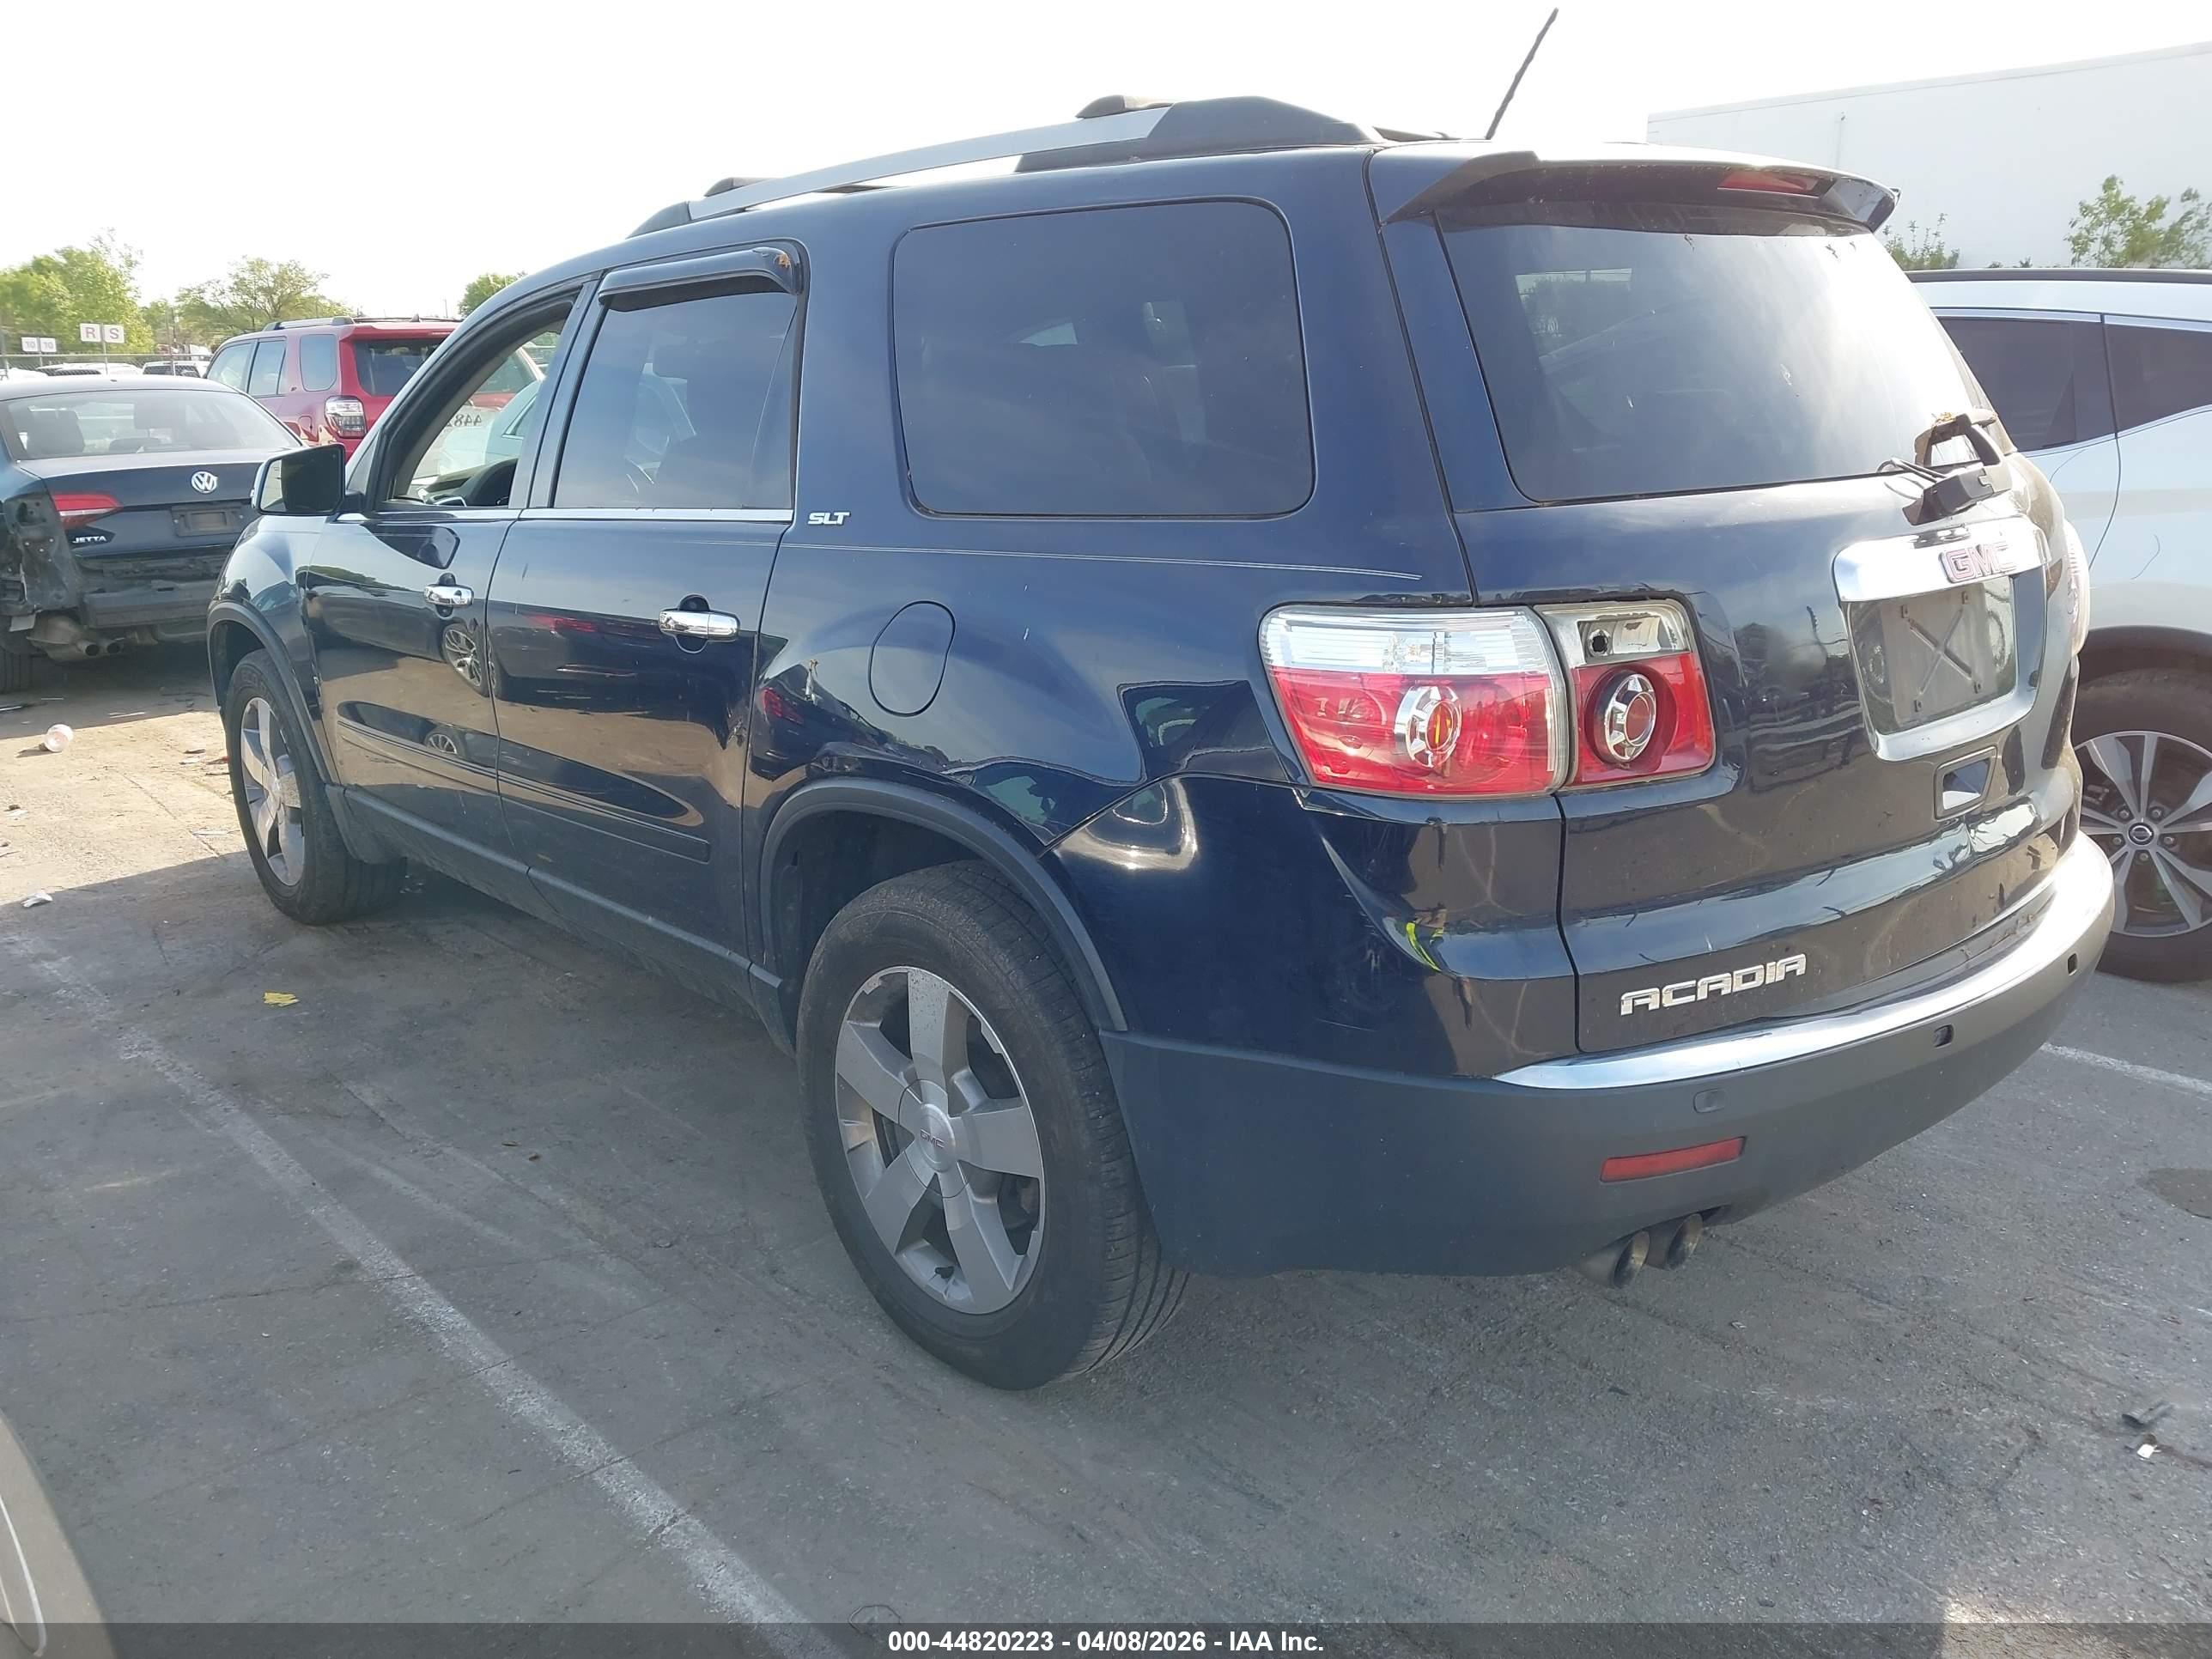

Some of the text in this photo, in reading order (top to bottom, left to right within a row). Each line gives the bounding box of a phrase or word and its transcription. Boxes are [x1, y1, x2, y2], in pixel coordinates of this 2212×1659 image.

[85, 326, 119, 340] R S
[807, 511, 851, 526] SLT
[72, 535, 107, 544] JETTA
[1939, 541, 2016, 584] GMC
[1620, 953, 1807, 1016] ACADIA
[920, 1127, 945, 1149] GMC
